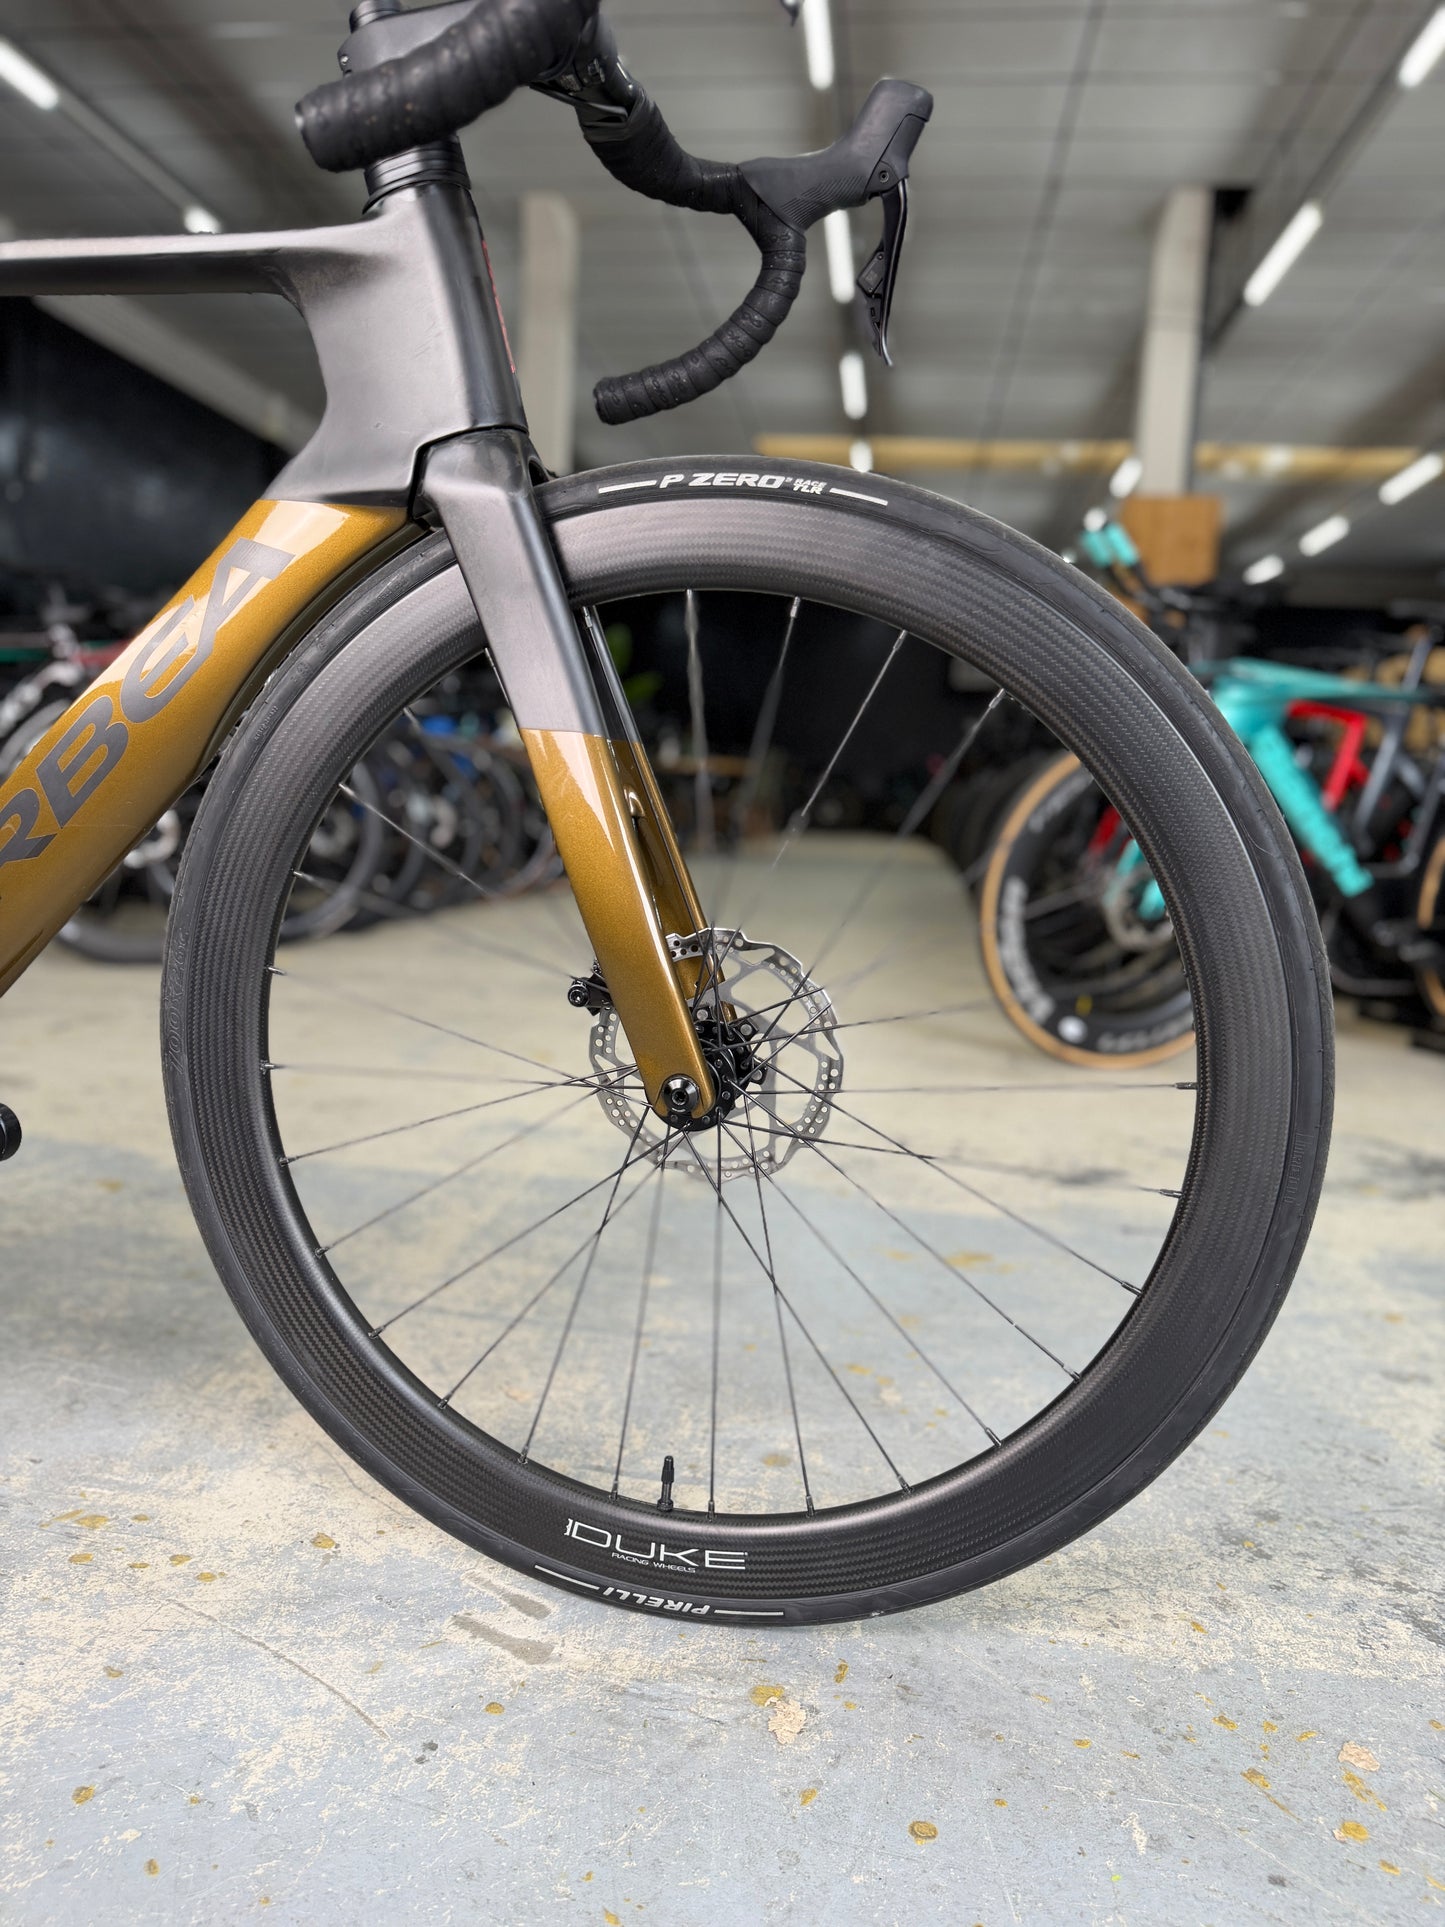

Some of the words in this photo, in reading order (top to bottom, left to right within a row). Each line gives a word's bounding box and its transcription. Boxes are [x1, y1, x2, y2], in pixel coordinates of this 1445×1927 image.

[659, 473, 684, 489] P
[688, 472, 786, 489] ZERO
[793, 484, 821, 495] TLR
[0, 537, 296, 868] RBEA
[571, 1521, 746, 1571] DUKE
[611, 1551, 649, 1567] RACING
[653, 1561, 696, 1574] WHEELS
[603, 1586, 710, 1616] PIRELLI
